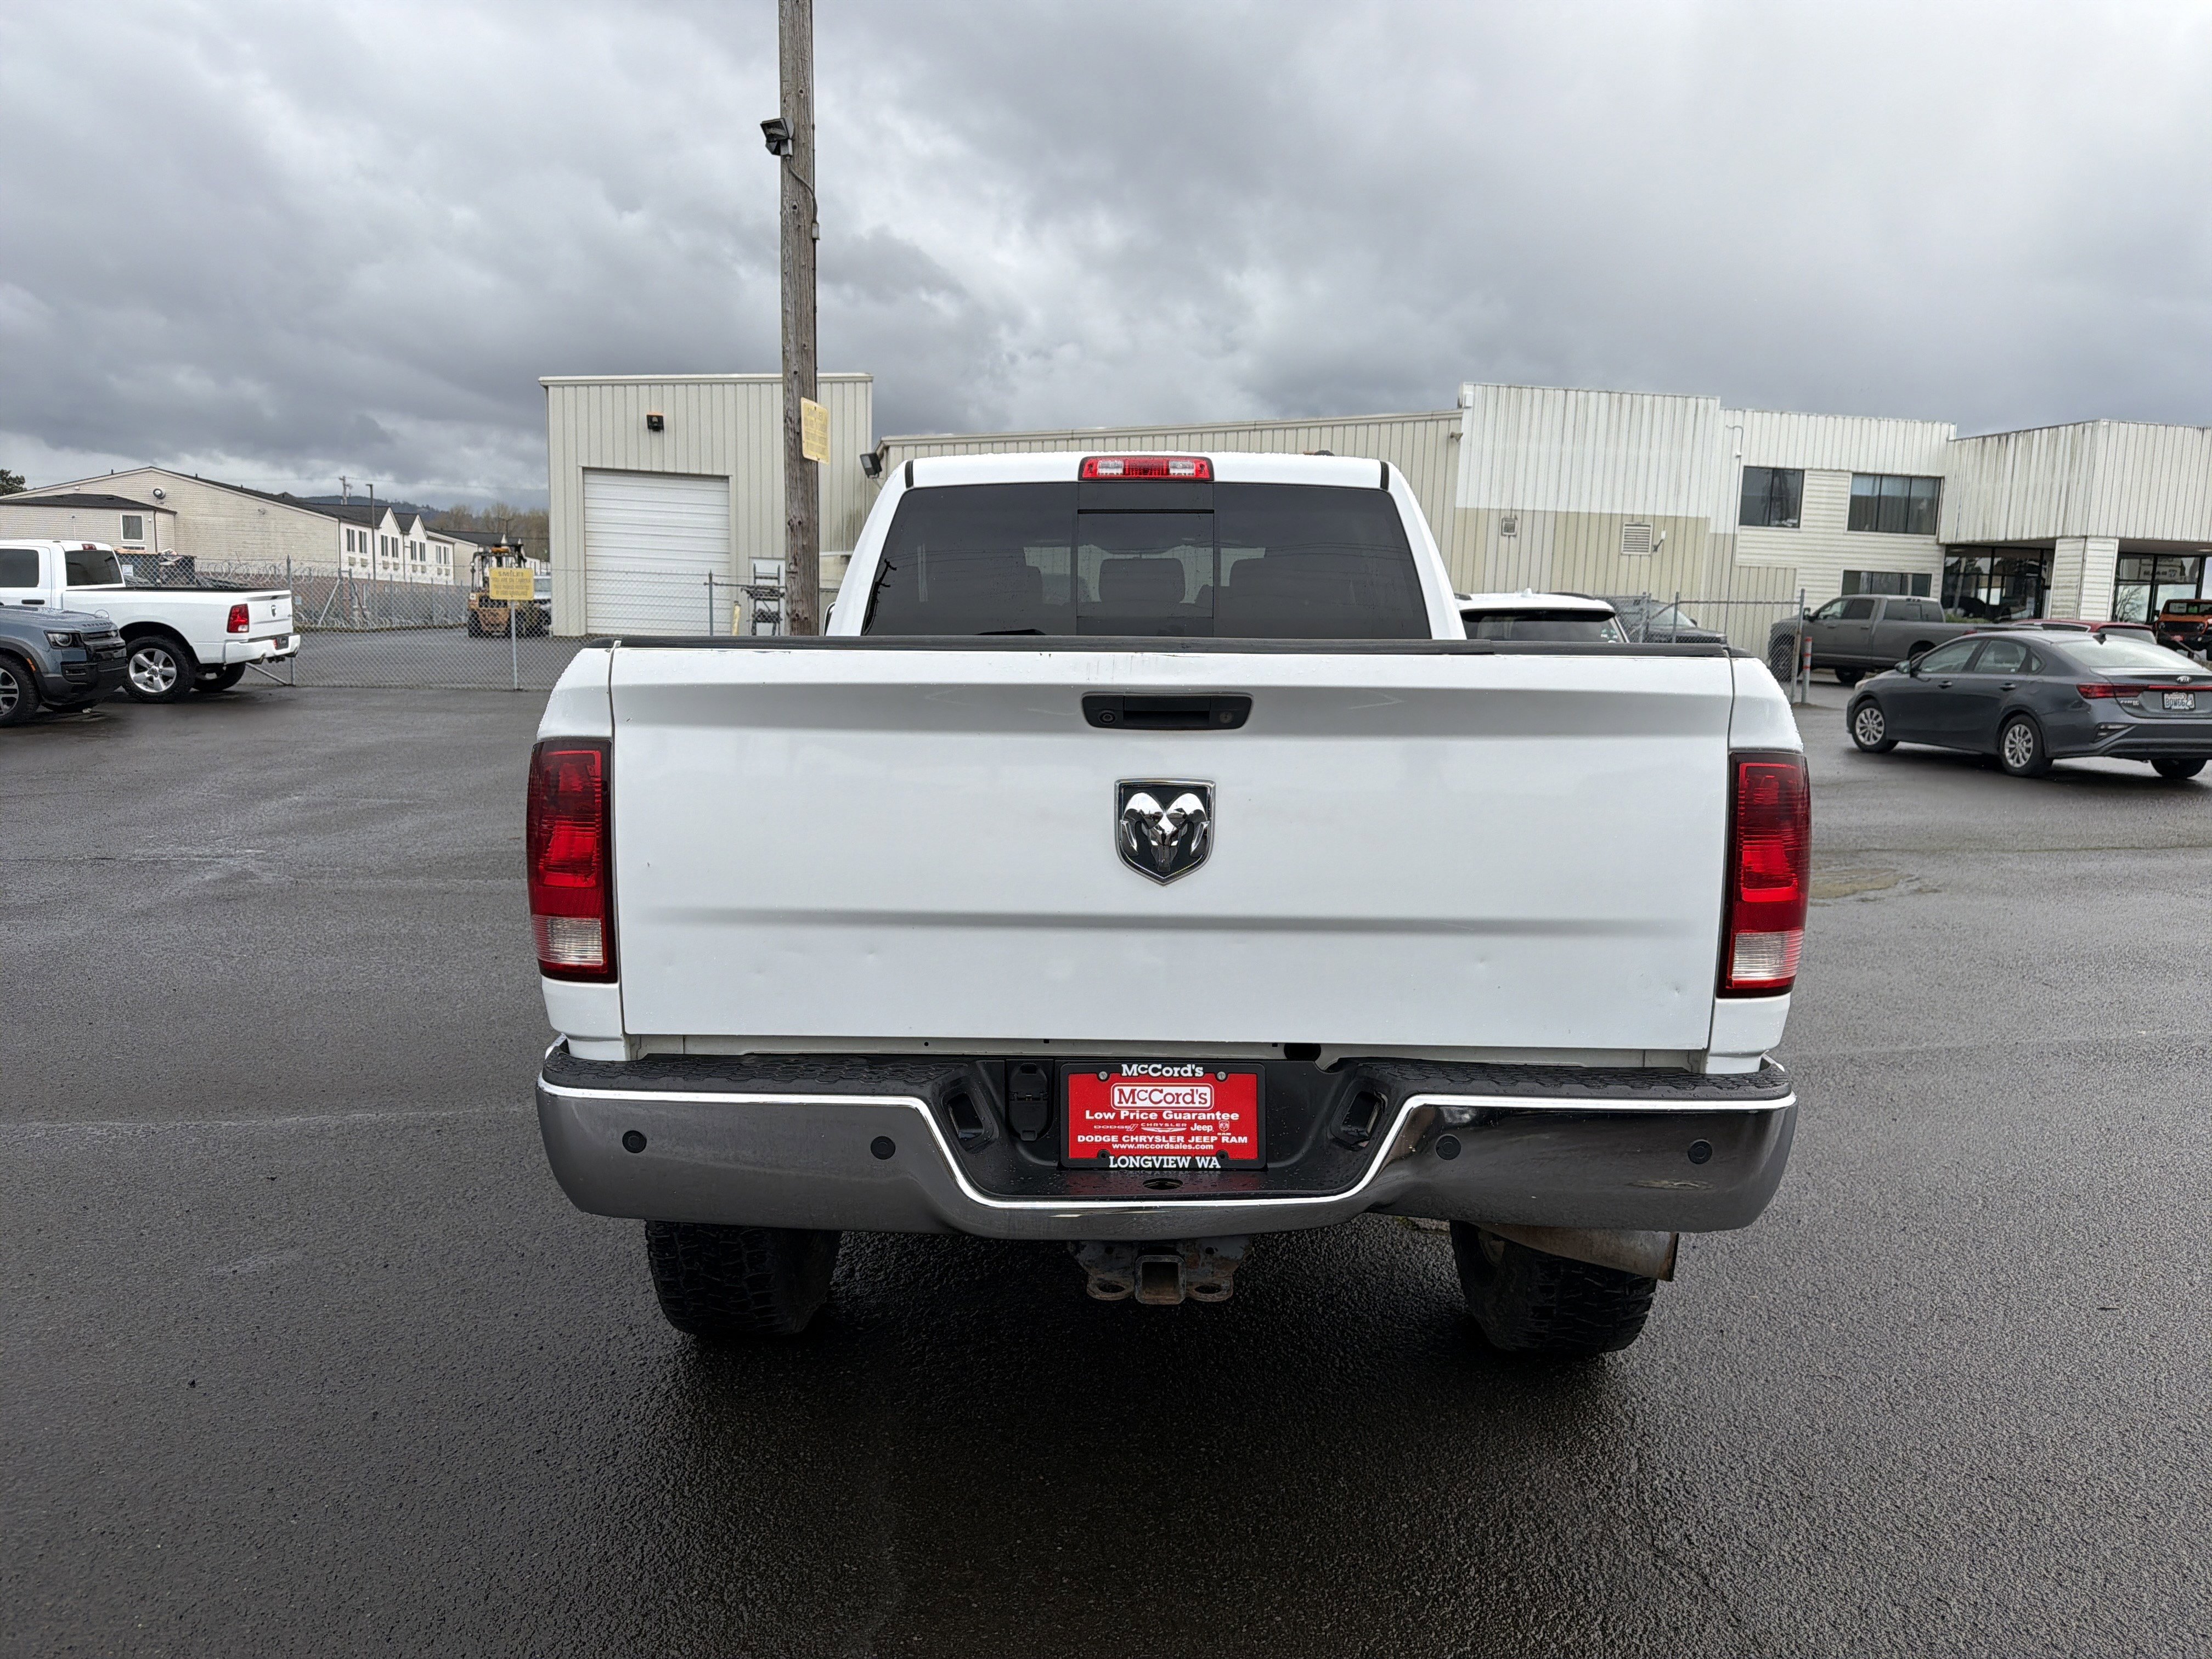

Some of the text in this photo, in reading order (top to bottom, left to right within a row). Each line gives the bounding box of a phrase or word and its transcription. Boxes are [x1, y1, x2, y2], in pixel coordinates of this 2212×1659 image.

[1085, 1110, 1239, 1120] Low Price Guarantee
[1190, 1123, 1214, 1132] Jeep
[1109, 1156, 1221, 1169] LONGVIEW WA
